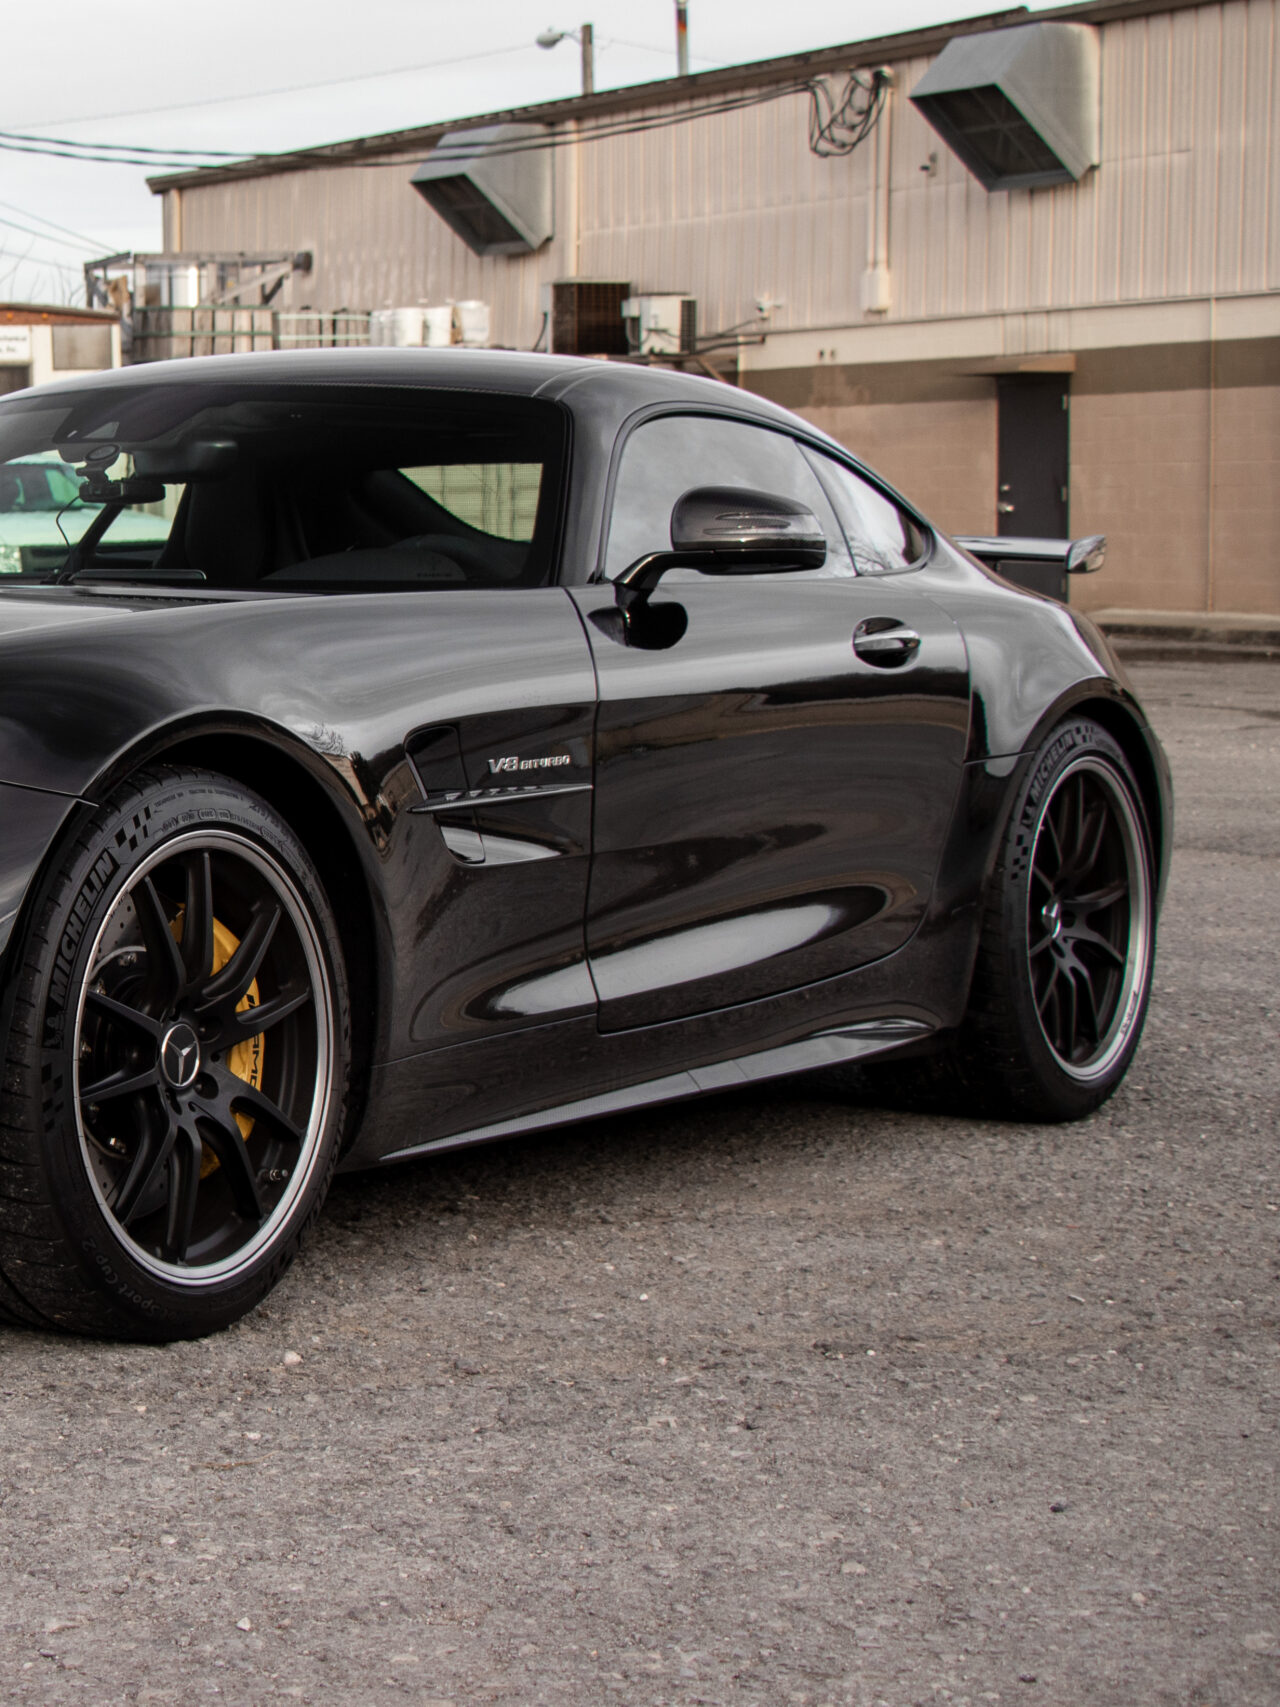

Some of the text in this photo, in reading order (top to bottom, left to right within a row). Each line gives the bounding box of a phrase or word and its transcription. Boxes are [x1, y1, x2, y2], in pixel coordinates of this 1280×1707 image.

[487, 754, 571, 774] V8 BITURBO
[48, 850, 116, 1008] MICHELIN
